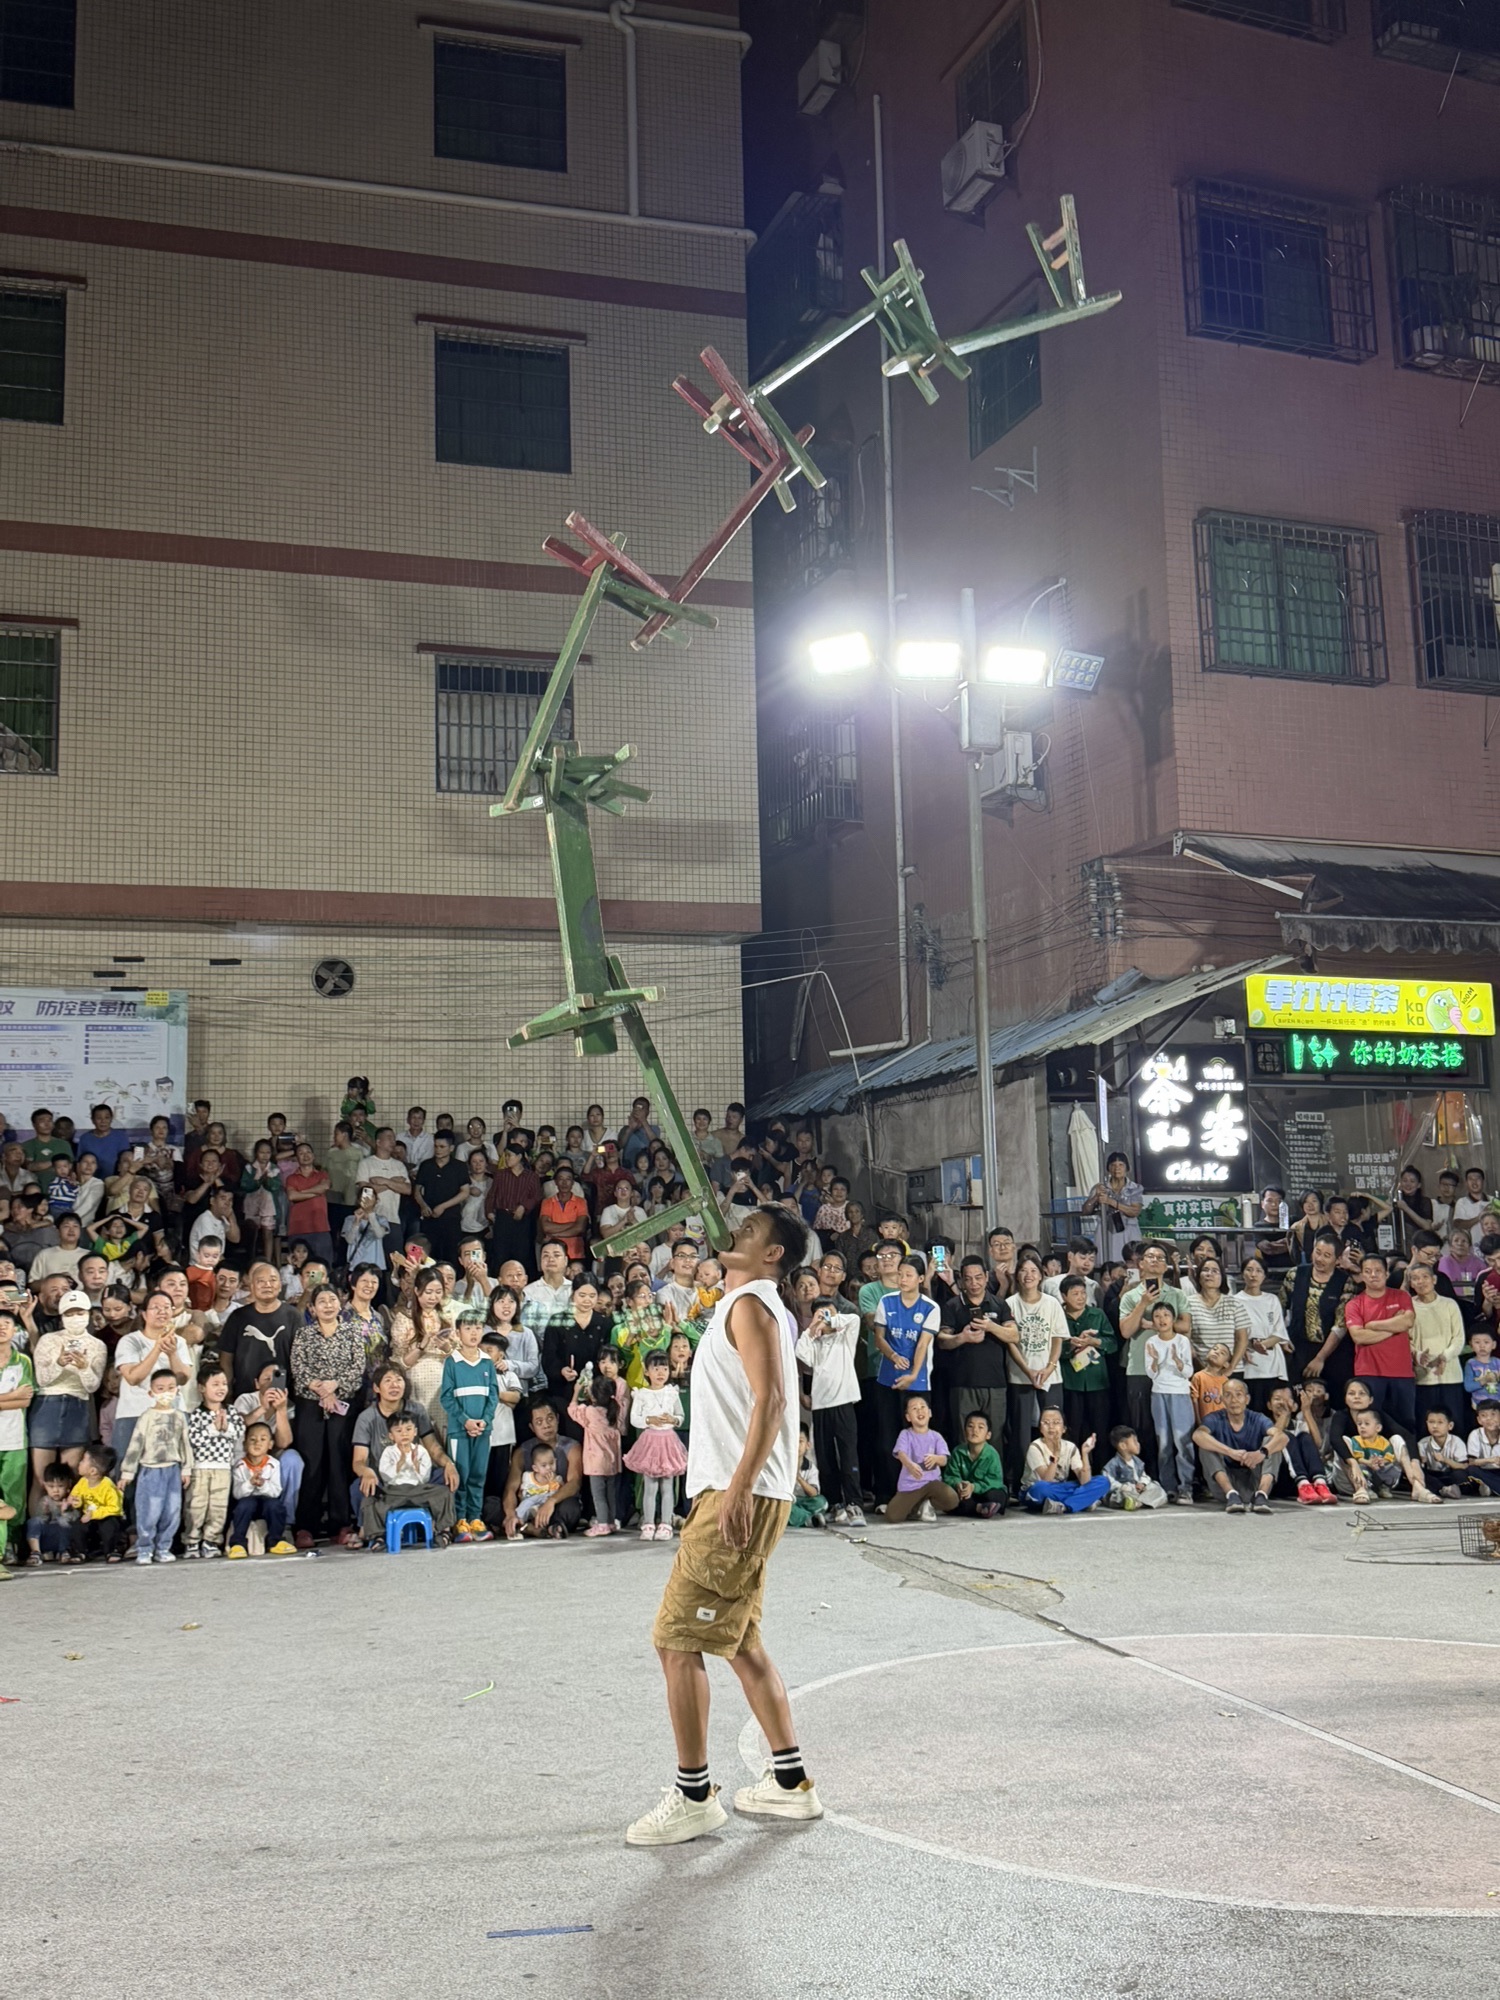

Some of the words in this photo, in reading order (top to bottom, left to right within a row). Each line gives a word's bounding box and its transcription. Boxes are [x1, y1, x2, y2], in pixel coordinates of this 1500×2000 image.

[1265, 979, 1402, 1014] 手打柠檬茶
[36, 1000, 138, 1018] 防控登革热
[1163, 1200, 1214, 1216] 真材实料
